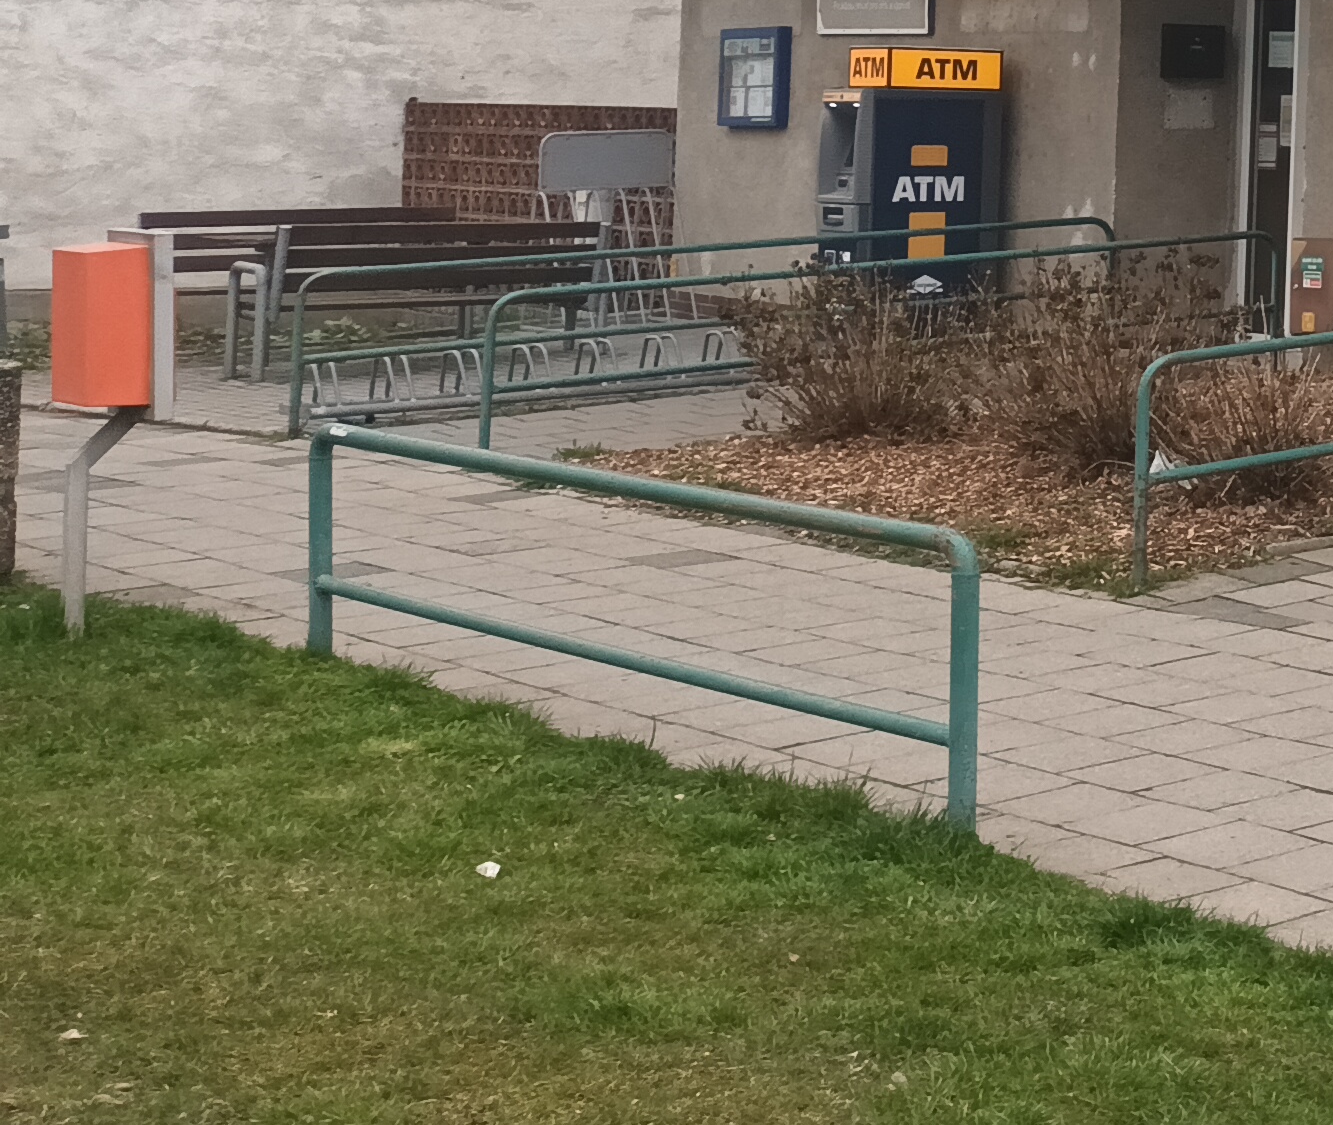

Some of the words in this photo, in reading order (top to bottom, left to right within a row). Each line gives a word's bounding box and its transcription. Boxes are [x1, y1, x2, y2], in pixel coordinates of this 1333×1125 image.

[852, 56, 885, 79] ATM
[915, 57, 978, 81] ATM
[892, 176, 965, 203] ATM
